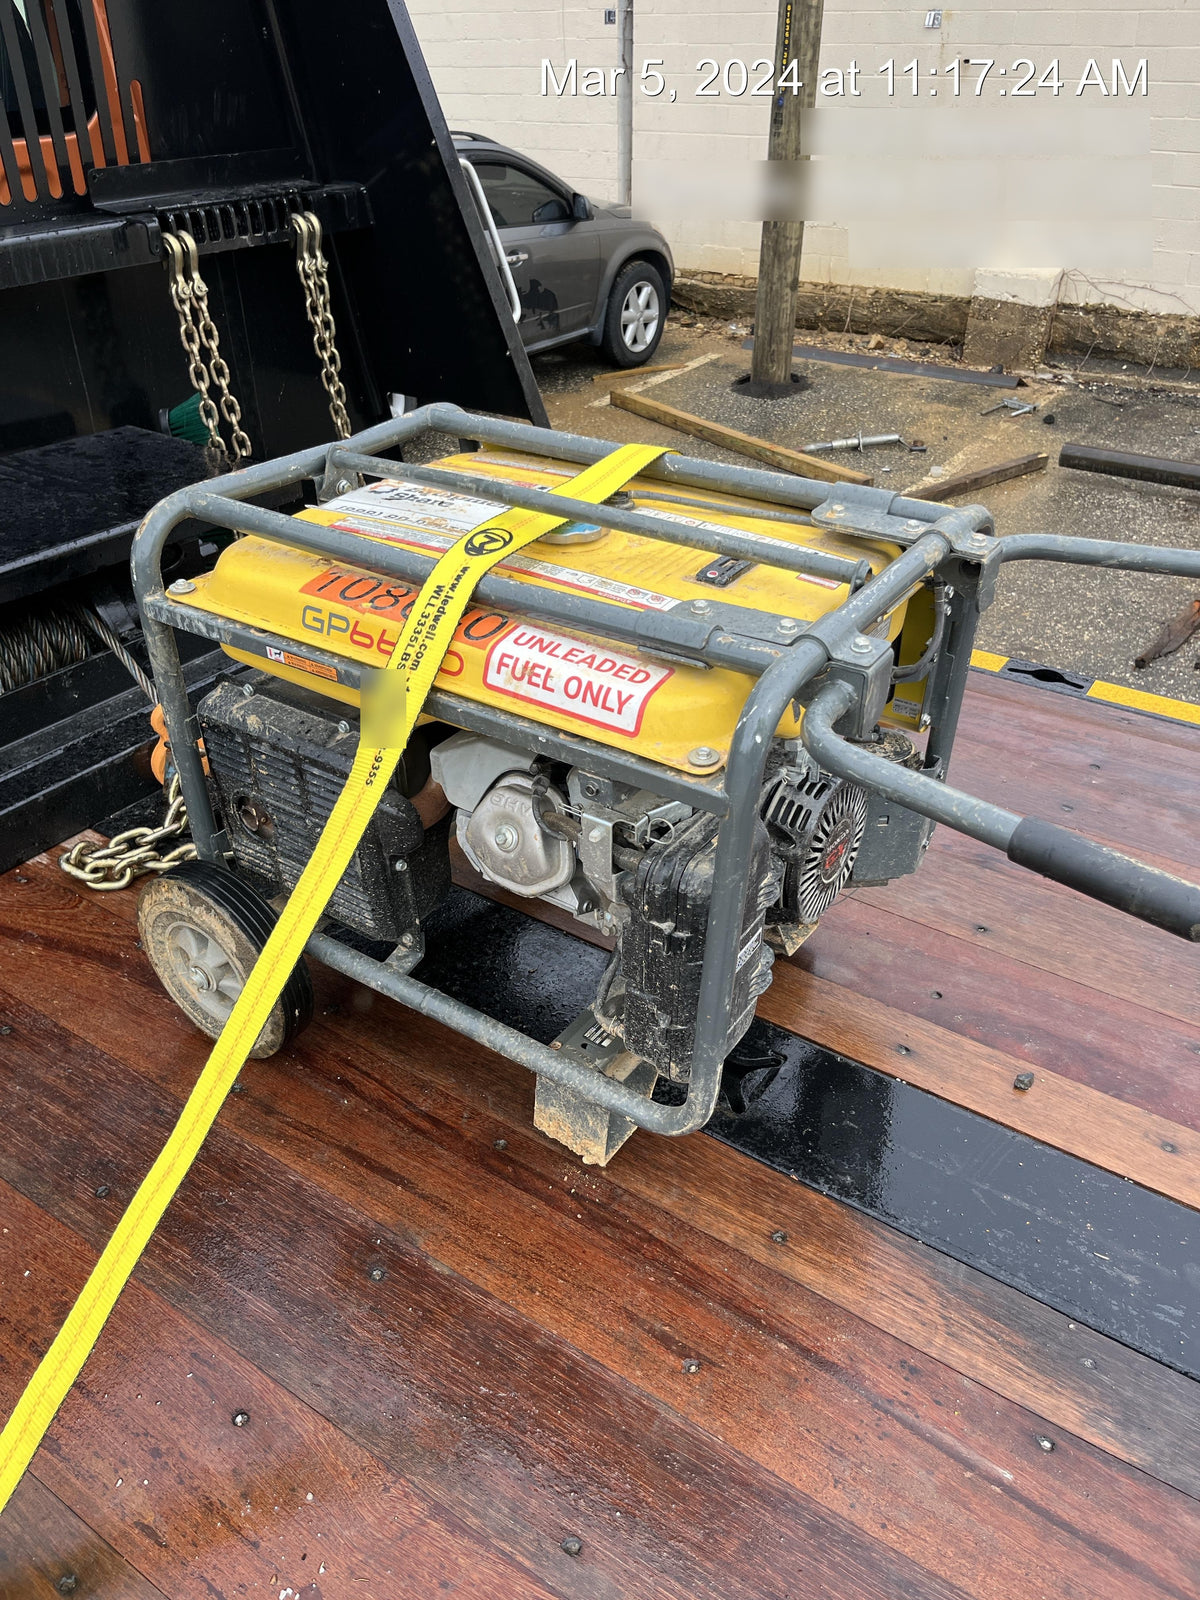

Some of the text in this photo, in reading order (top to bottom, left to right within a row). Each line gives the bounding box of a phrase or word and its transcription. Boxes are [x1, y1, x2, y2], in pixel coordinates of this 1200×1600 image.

[409, 565, 470, 672] www.ledwell.com
[424, 584, 446, 610] WLL
[496, 652, 635, 716] FUEL ONLY
[512, 631, 651, 684] UNLEADED
